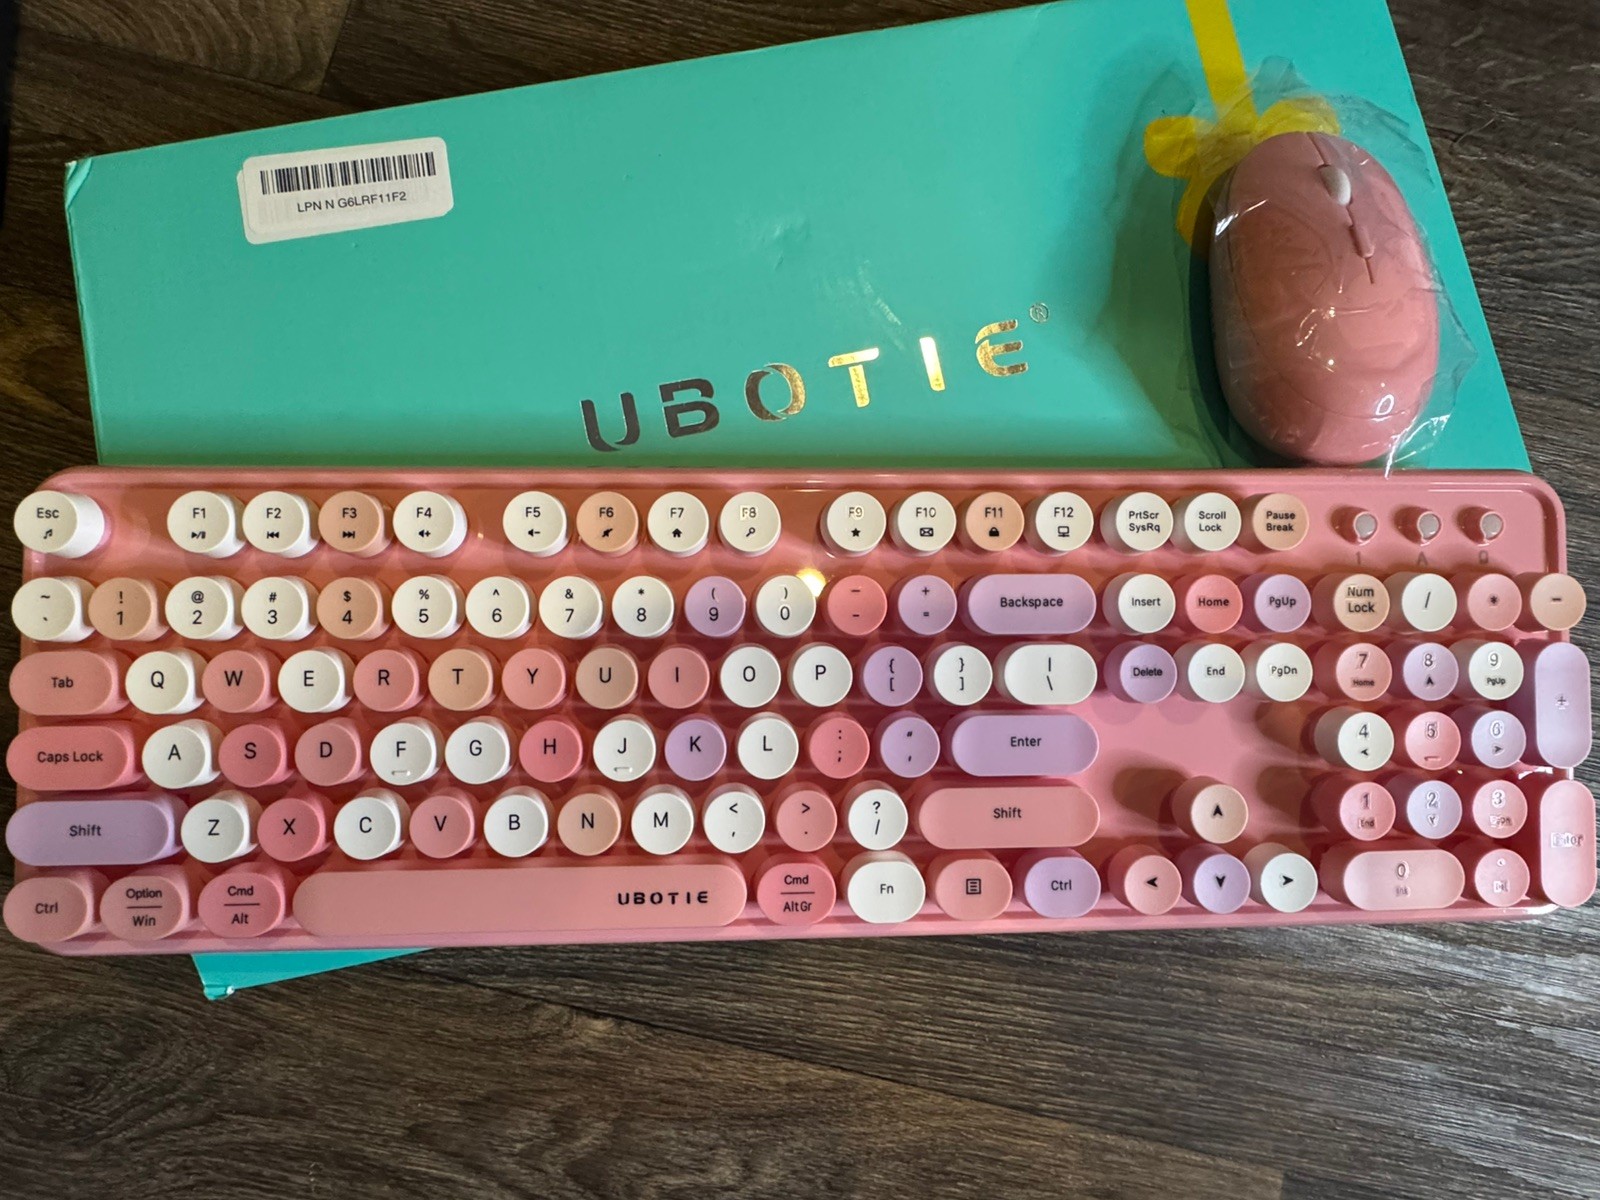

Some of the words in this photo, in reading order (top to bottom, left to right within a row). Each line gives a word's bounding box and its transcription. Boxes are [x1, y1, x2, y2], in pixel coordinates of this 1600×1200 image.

[297, 200, 321, 212] LPN
[325, 200, 335, 209] N
[338, 191, 406, 208] G6LRF11F2
[580, 319, 1028, 452] UBOTIE
[37, 508, 59, 519] Esc
[193, 508, 205, 518] F1
[267, 508, 281, 519] F2
[343, 508, 357, 518] F3
[417, 507, 431, 518] F4
[526, 507, 540, 517] F5
[600, 507, 614, 518] F6
[671, 508, 684, 518] F7
[743, 507, 756, 518] F8
[849, 507, 862, 517] F9
[916, 507, 936, 518] F10
[985, 507, 1002, 517] F11
[1054, 507, 1073, 517] F12
[1129, 511, 1159, 519] PrtScr
[1199, 511, 1226, 520] Scroll
[1267, 511, 1295, 520] Pause
[1129, 523, 1160, 533] SysRq
[1199, 524, 1222, 532] Lock
[1267, 523, 1293, 531] Break
[1348, 587, 1374, 597] Num
[1000, 597, 1063, 609] Backspace
[1132, 598, 1160, 606] Insert
[1199, 598, 1229, 606] Home
[1270, 597, 1296, 608] PgUp
[1349, 602, 1375, 612] Lock
[117, 611, 123, 625] 1
[193, 610, 202, 624] 2
[268, 610, 277, 624] 3
[342, 610, 352, 624] 4
[419, 609, 429, 623] 5
[492, 608, 502, 622] 6
[566, 609, 574, 622] 7
[637, 608, 646, 622] 8
[709, 607, 718, 621] 9
[780, 606, 790, 620] 0
[1359, 653, 1367, 668] 7
[1425, 653, 1433, 667] 8
[1490, 653, 1498, 666] 9
[224, 670, 243, 686] W
[379, 669, 389, 685] R
[452, 669, 464, 684] T
[527, 668, 538, 684] Y
[600, 667, 611, 683] U
[743, 666, 755, 682] O
[816, 665, 826, 680] P
[1133, 668, 1163, 676] Delete
[1207, 667, 1225, 675] End
[1272, 666, 1297, 677] PgDn
[51, 677, 73, 688] Tab
[151, 671, 164, 689] Q
[304, 671, 314, 686] E
[1359, 724, 1368, 738] 4
[1427, 723, 1436, 738] 5
[1493, 723, 1500, 736] 6
[397, 741, 406, 757] F
[470, 740, 482, 756] G
[544, 738, 556, 754] H
[618, 738, 626, 754] J
[690, 736, 701, 752] K
[763, 736, 772, 751] L
[1011, 737, 1041, 747] Enter
[168, 744, 181, 760] A
[245, 742, 256, 759] S
[320, 742, 332, 758] D
[38, 751, 69, 764] Caps
[73, 751, 103, 762] Lock
[1363, 793, 1369, 809] 1
[1429, 793, 1438, 808] 2
[1494, 791, 1503, 805] 3
[654, 812, 668, 827] M
[994, 807, 1021, 818] Shift
[208, 819, 219, 836] Z
[283, 818, 295, 835] X
[360, 817, 372, 833] C
[434, 816, 447, 831] V
[509, 814, 520, 830] B
[582, 813, 594, 828] N
[70, 825, 101, 837] Shift
[1397, 863, 1405, 877] 0
[784, 875, 809, 885] Cmd
[1051, 880, 1071, 891] Ctrl
[126, 888, 162, 900] Option
[228, 886, 253, 896] Cmd
[880, 884, 893, 894] Fn
[618, 891, 707, 905] UBOTIE
[35, 902, 58, 914] Ctrl
[133, 916, 156, 926] Win
[232, 913, 248, 924] Alt
